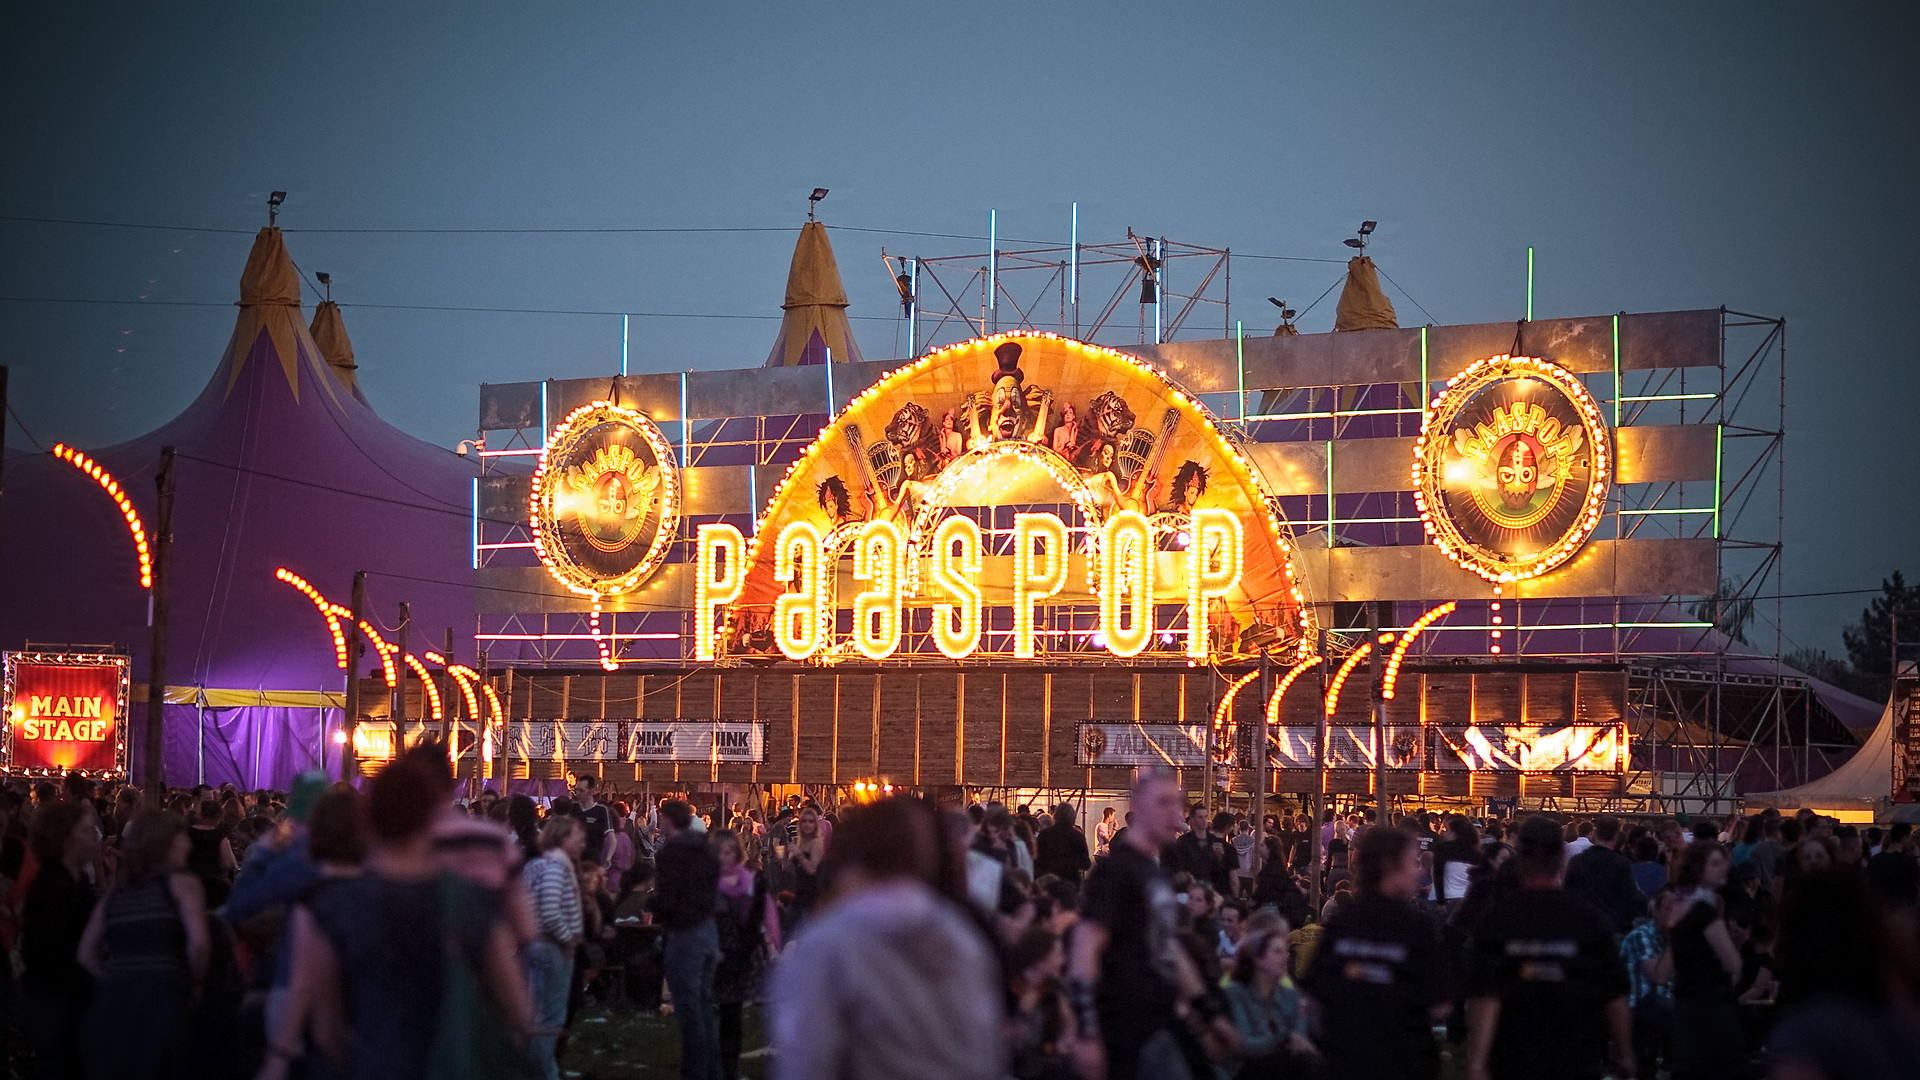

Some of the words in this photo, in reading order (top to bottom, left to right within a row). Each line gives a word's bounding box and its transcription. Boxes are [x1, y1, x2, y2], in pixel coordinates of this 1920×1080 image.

[30, 695, 102, 718] MAIN
[23, 719, 106, 742] STAGE
[635, 731, 674, 746] KINK
